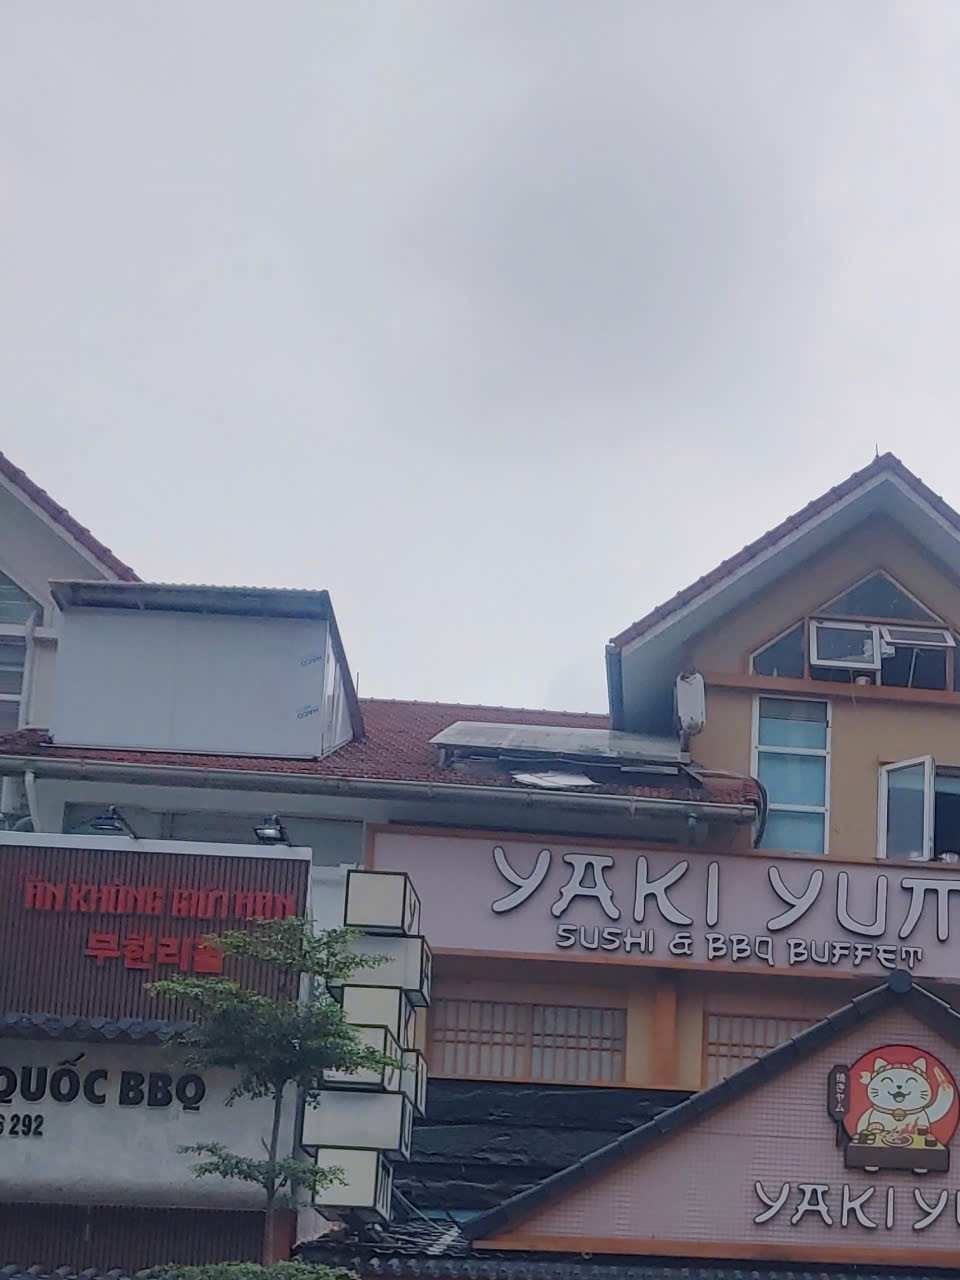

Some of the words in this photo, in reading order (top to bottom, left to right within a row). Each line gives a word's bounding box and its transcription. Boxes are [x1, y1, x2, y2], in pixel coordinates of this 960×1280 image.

[69, 882, 165, 915] KHÔNG
[492, 846, 720, 926] YAKI
[555, 923, 655, 953] SUSHI
[669, 931, 694, 956] &
[706, 931, 776, 967] BBQ
[787, 938, 924, 969] BUFFET
[118, 1070, 206, 1111] BBQ
[9, 1113, 44, 1136] 292
[752, 1181, 895, 1230] YAKI
